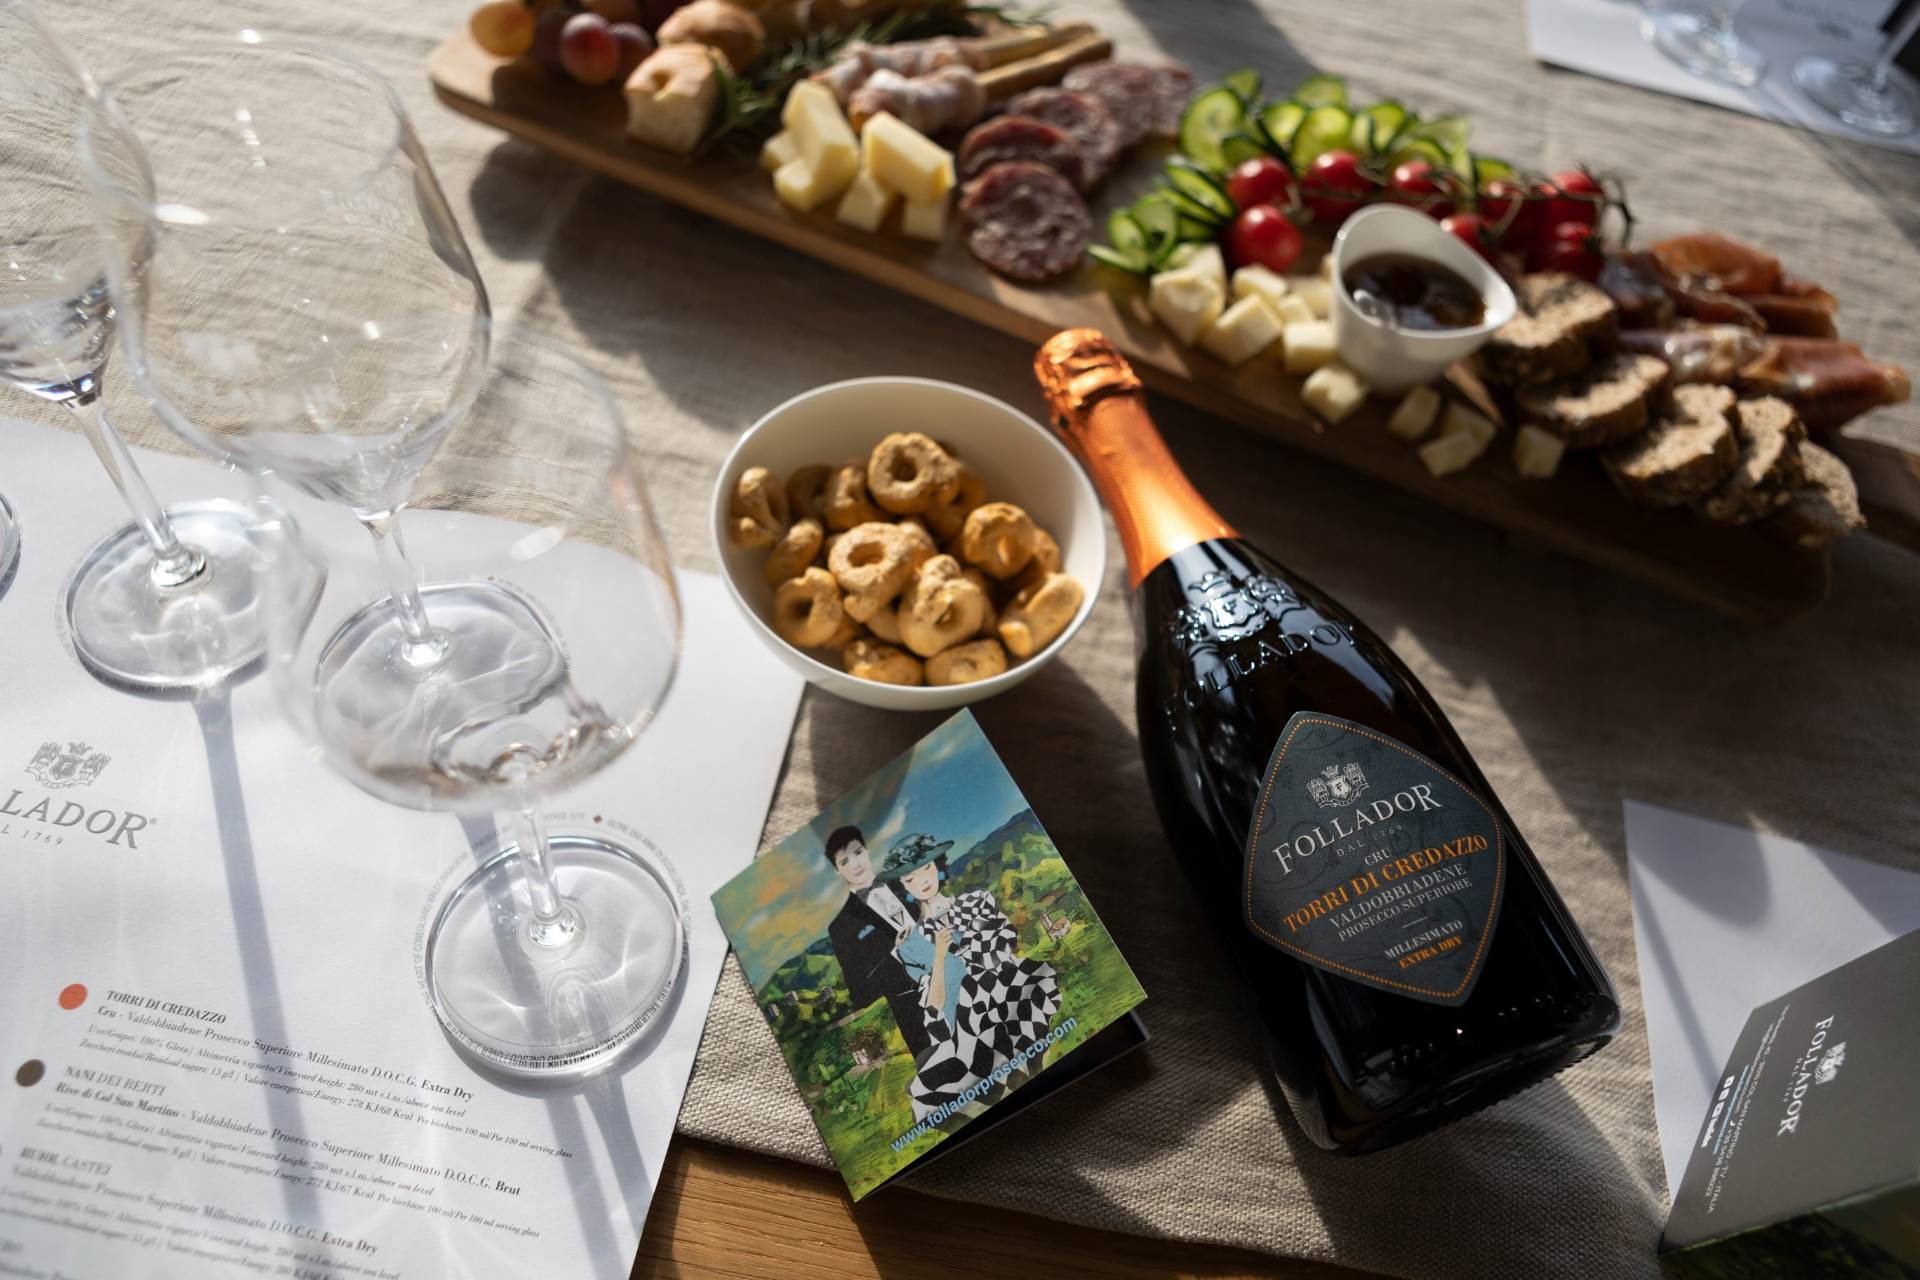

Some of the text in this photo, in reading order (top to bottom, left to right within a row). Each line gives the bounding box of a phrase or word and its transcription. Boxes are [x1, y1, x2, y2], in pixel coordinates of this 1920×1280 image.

[1272, 783, 1443, 876] FOLLADOR
[1364, 847, 1393, 866] CRU
[1283, 834, 1488, 933] TORRI DI CREDAZZO
[1330, 863, 1467, 929] VALDOBBIADENE
[1338, 877, 1472, 942] PROSECCO SUPERIORE
[1384, 919, 1464, 960] MILLESIMATO
[1399, 935, 1463, 969] EXTRA DRY
[106, 990, 227, 1024] TORRI DI CREDAZZO
[64, 1066, 167, 1097] NANI DEI BERTI
[97, 1005, 475, 1103] Cru Valdobbiadene Prosecco Superiore Millesimato D.O.C.G. Extra Dry
[1777, 1014, 1834, 1137] FOLLADOR
[431, 1104, 445, 1114] sea
[446, 1106, 467, 1118] level
[890, 1015, 1079, 1153] www.folladorprosecco.com
[55, 1082, 81, 1096] Rive
[81, 1087, 94, 1099] di
[136, 1099, 180, 1118] Martino
[190, 1110, 269, 1137] Valdobbiadene
[270, 1128, 319, 1149] Prosecco
[320, 1140, 375, 1162] Superiore
[376, 1152, 441, 1177] Millesimato
[444, 1168, 492, 1190] D.O.C.G.
[495, 1180, 521, 1196] Brut
[393, 1108, 414, 1122] Kcal
[504, 1136, 519, 1146] 100
[202, 1204, 267, 1230] Millesimato
[320, 1231, 353, 1249] Extra
[356, 1238, 379, 1257] Dry
